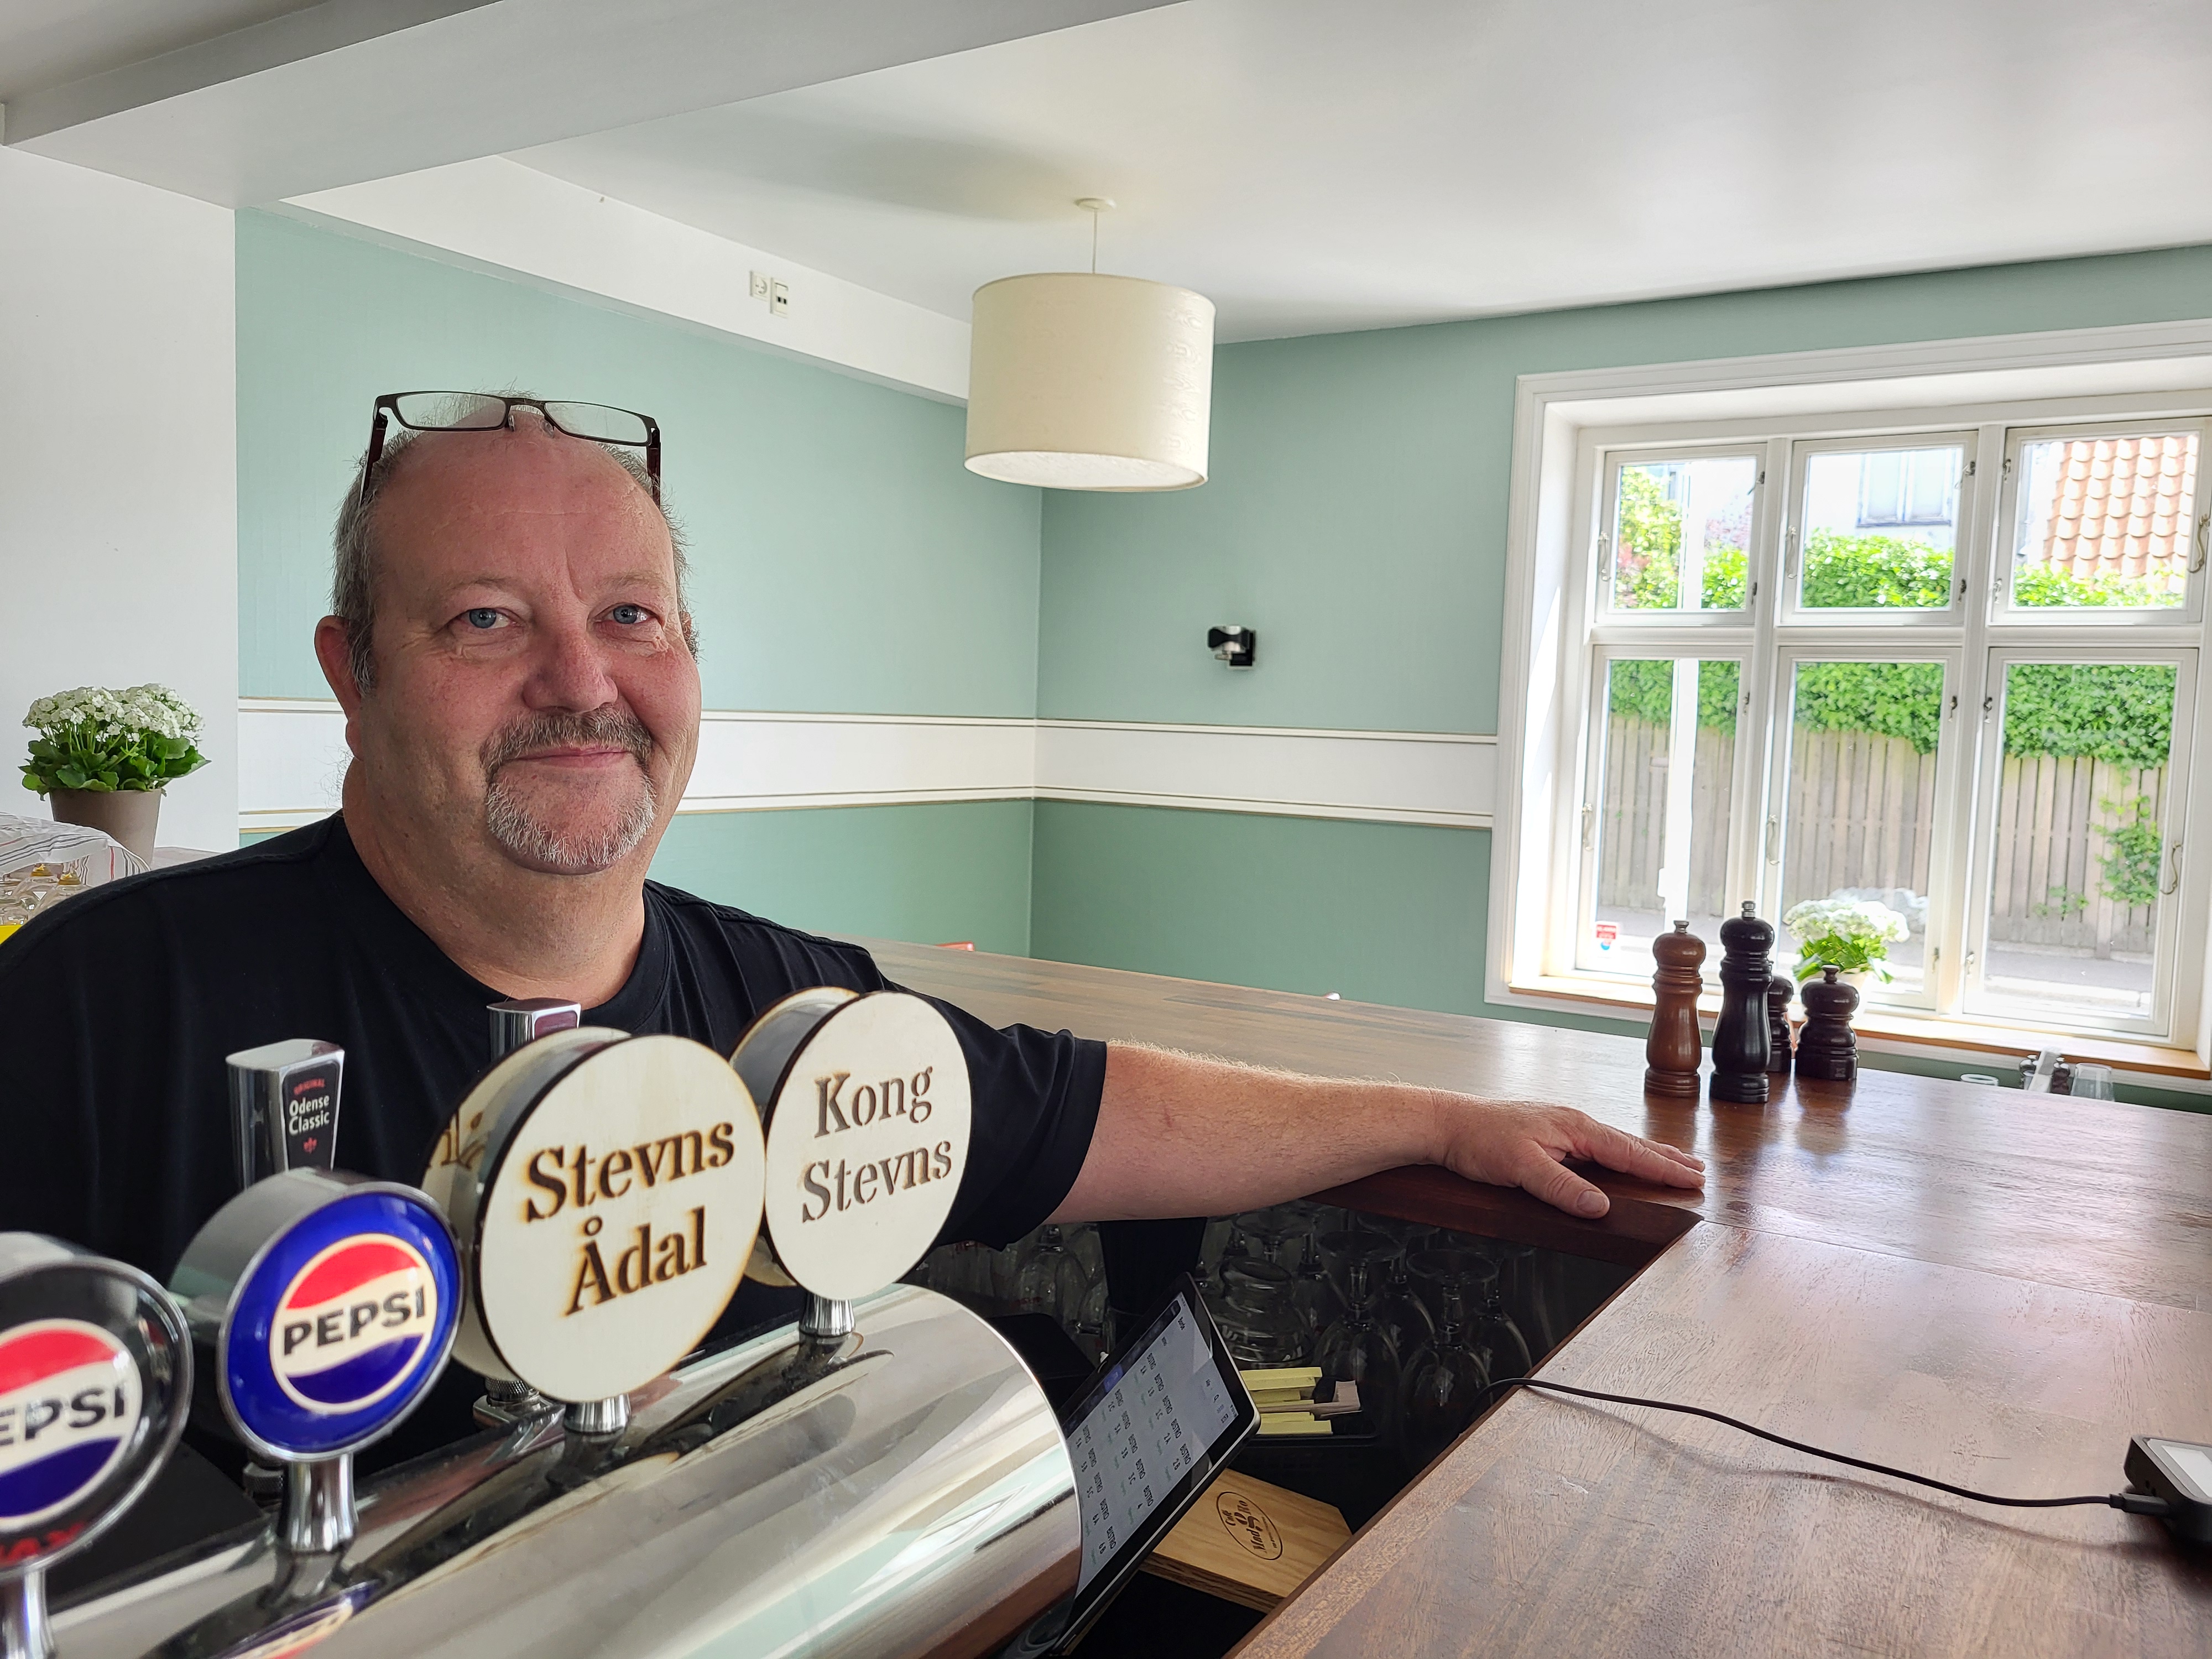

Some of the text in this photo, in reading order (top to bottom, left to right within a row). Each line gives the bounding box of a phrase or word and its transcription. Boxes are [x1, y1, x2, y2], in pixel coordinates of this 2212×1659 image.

[289, 1095, 330, 1117] Odense
[814, 1066, 933, 1139] Kong
[289, 1110, 330, 1135] Classic
[525, 1122, 734, 1223] Stevns
[802, 1140, 951, 1223] Stevns
[565, 1206, 707, 1316] Ådal
[284, 1285, 425, 1356] PEPSI
[1140, 1365, 1147, 1375] 1A
[1147, 1353, 1156, 1370] BISTRO
[1148, 1386, 1155, 1397] 1B
[1154, 1374, 1164, 1391] BISTRO
[1108, 1401, 1115, 1412] 2C
[1115, 1389, 1124, 1407] BISTRO
[1162, 1395, 1173, 1414] BISTRO
[0, 1384, 125, 1447] EPSI
[1121, 1411, 1131, 1430] BISTRO
[1082, 1425, 1091, 1444] BISTRO
[1164, 1432, 1171, 1444] 2A
[1171, 1418, 1182, 1438] BISTRO
[1121, 1447, 1129, 1459] 3B
[1128, 1433, 1138, 1454] BISTRO
[1088, 1447, 1097, 1468] BISTRO
[1172, 1458, 1181, 1470] 2B
[1180, 1443, 1191, 1465] BISTRO
[1128, 1472, 1136, 1485] 3C
[1135, 1458, 1146, 1479] BISTRO
[1086, 1486, 1094, 1498] 5C
[1094, 1472, 1103, 1493] BISTRO
[1143, 1485, 1154, 1507] BISTRO
[1092, 1513, 1100, 1525] 6A
[1100, 1498, 1110, 1520] BISTRO
[1107, 1526, 1117, 1549] BISTRO
[1246, 1528, 1267, 1553] Mad
[1099, 1542, 1107, 1554] 6B
